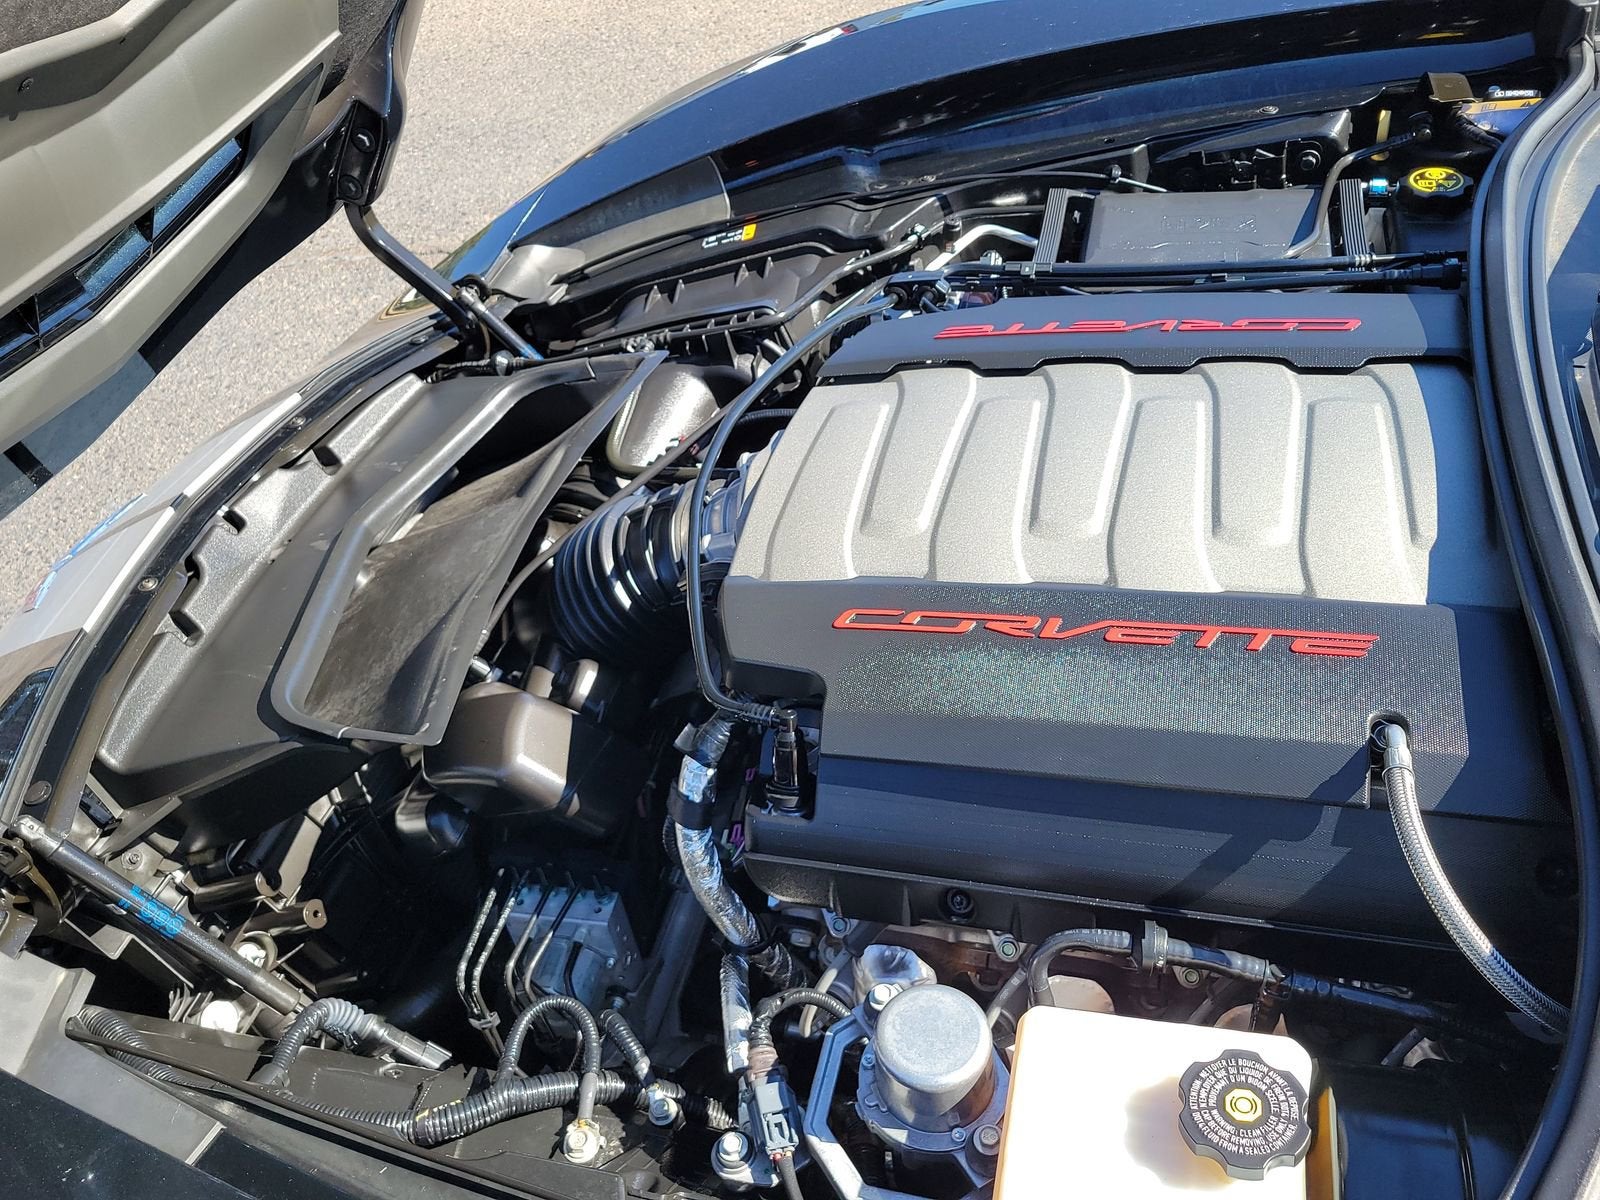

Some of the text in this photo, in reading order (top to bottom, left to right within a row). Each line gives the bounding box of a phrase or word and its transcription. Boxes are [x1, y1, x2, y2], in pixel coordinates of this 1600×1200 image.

[934, 318, 1362, 340] CORVETTE
[832, 608, 1380, 657] CORVETTE
[1227, 1058, 1237, 1066] LE
[1238, 1058, 1269, 1075] BOUCHON
[1267, 1070, 1289, 1088] AVANT
[1283, 1087, 1294, 1097] LA
[1228, 1066, 1238, 1075] DU
[1262, 1075, 1274, 1087] DE
[1247, 1075, 1268, 1092] BIDON
[1200, 1109, 1213, 1121] CAP
[1207, 1120, 1231, 1141] BEFORE
[1265, 1130, 1280, 1143] USE
[1275, 1117, 1288, 1135] ONLY
[1239, 1128, 1263, 1138] CLEAN
[1259, 1115, 1279, 1135] FILLER
[1201, 1125, 1220, 1143] FLUID
[1218, 1139, 1239, 1154] FROM
[1244, 1146, 1271, 1156] SEALED
